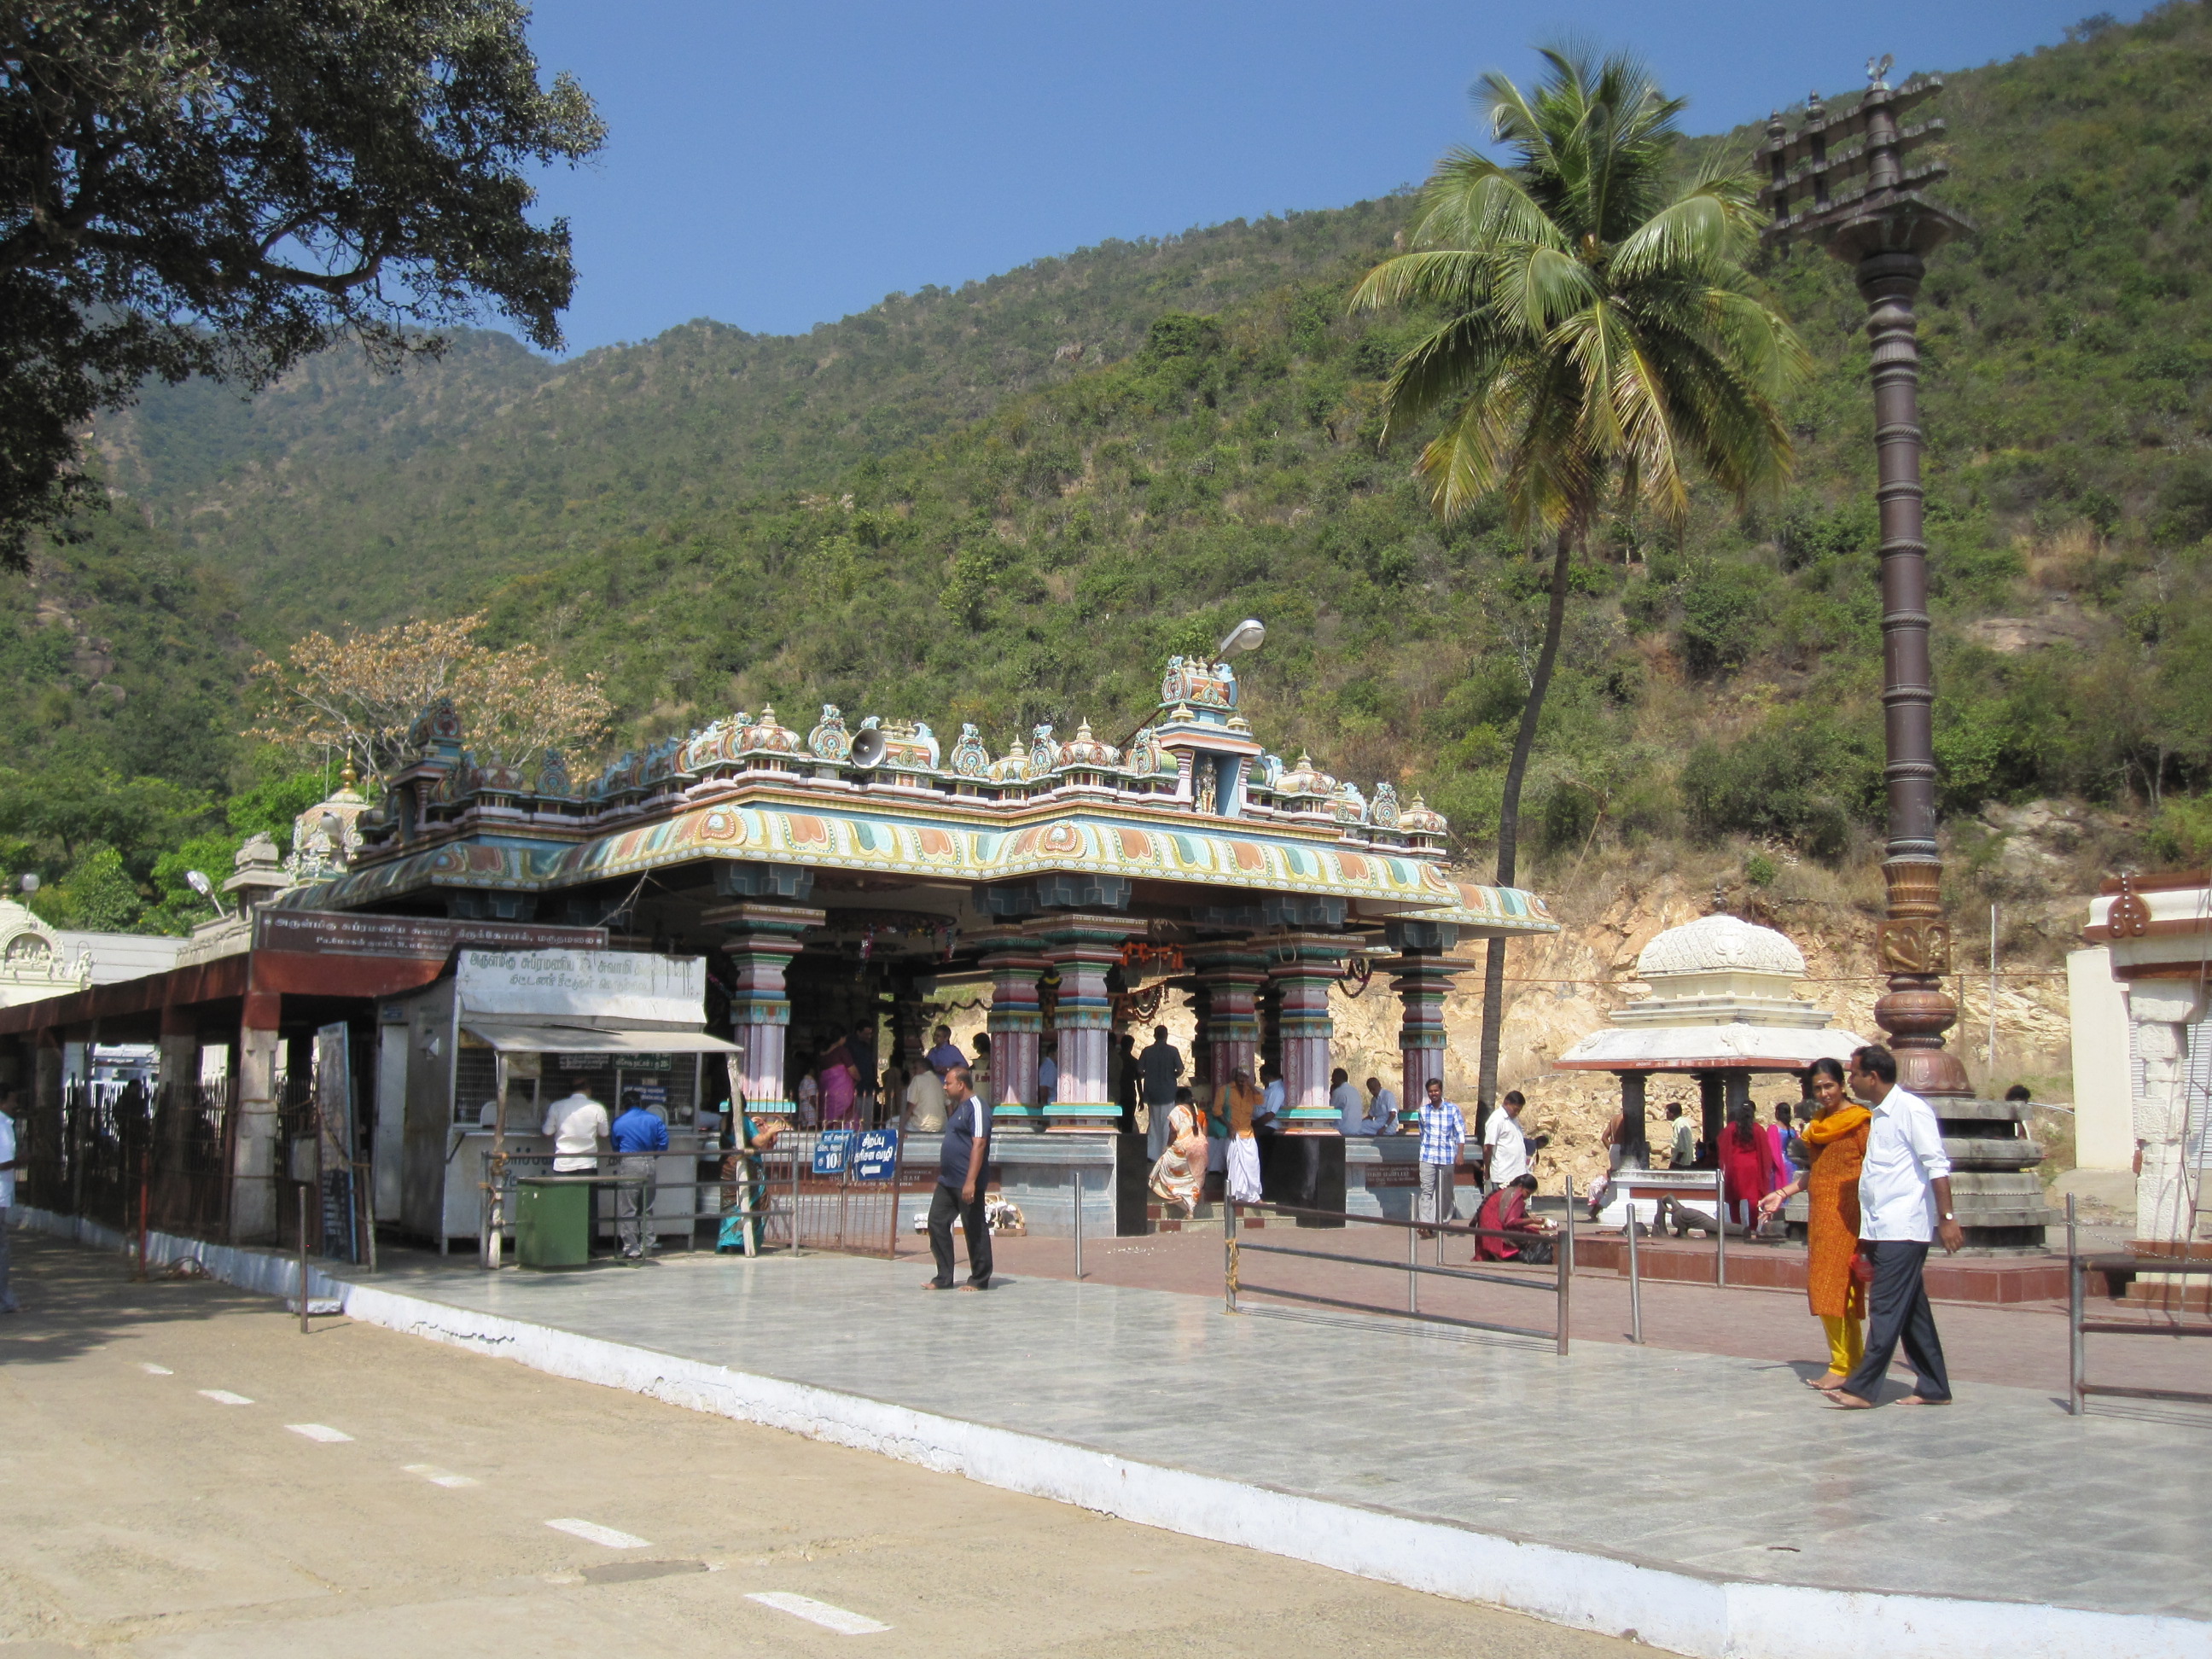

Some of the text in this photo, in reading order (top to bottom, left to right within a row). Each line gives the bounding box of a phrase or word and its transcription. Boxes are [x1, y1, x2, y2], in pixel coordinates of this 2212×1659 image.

[274, 918, 337, 931] அருள்மிகு
[470, 952, 516, 969] அருள்மிகு
[521, 952, 574, 972] சுப்ரமணிய
[597, 959, 632, 974] சுவாமி
[862, 1133, 885, 1150] சிறப்பு
[853, 1146, 894, 1163] தரிசன வழி
